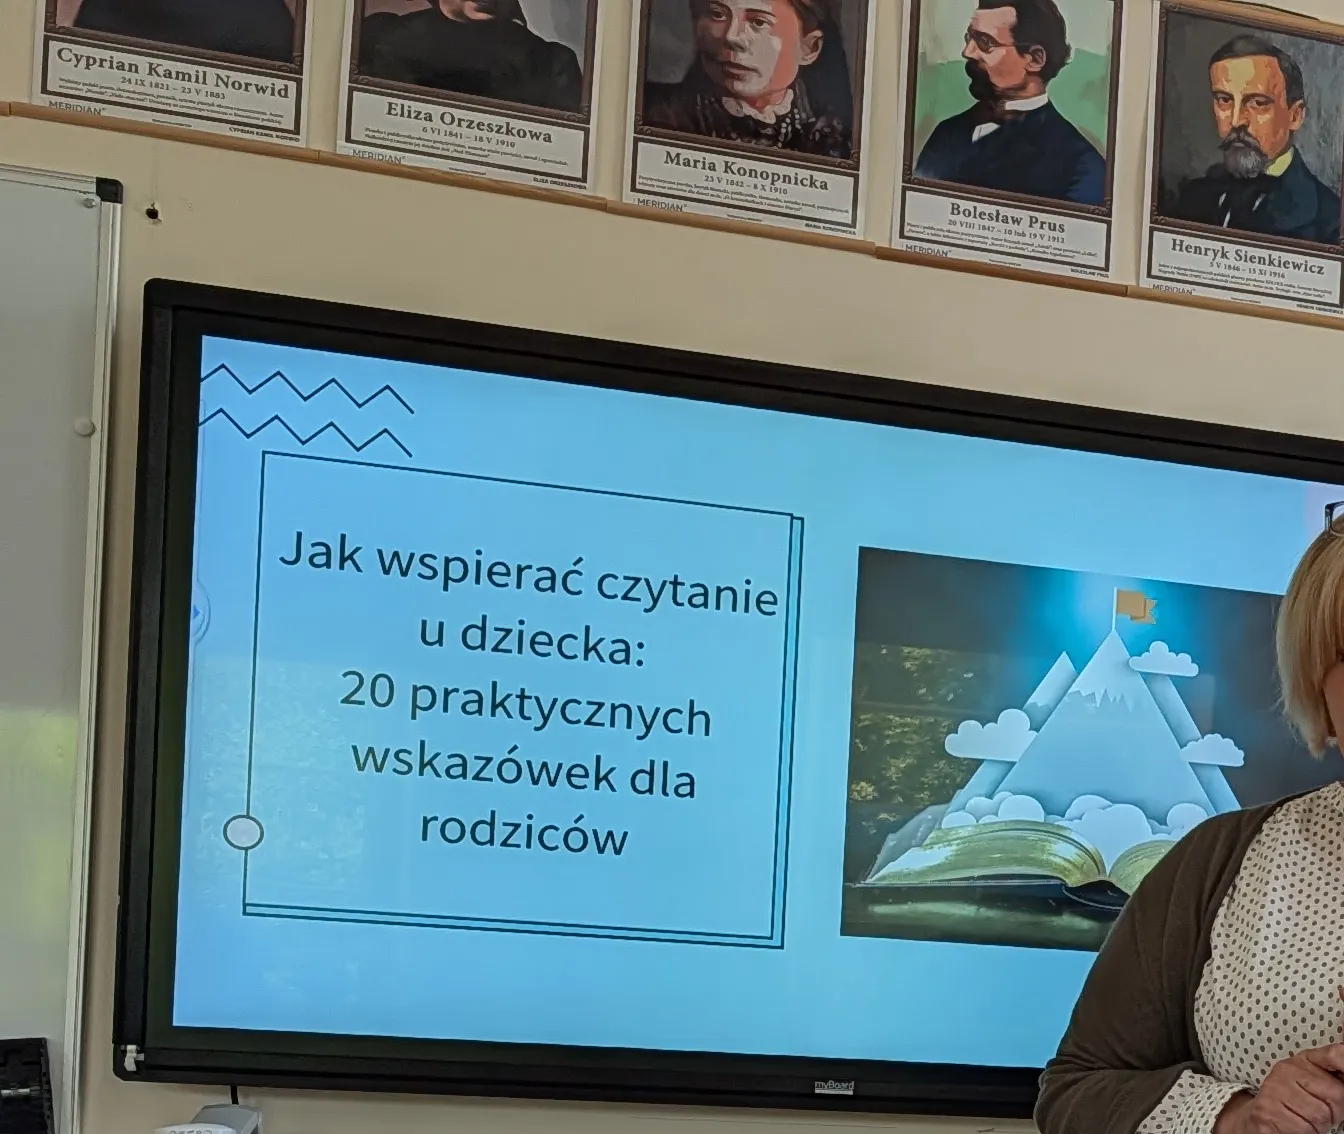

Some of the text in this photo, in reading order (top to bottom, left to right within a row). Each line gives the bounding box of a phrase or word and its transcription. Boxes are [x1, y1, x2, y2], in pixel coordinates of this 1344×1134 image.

[57, 47, 289, 98] Cyprian Kamil Norwid
[120, 76, 132, 84] 24
[134, 78, 146, 87] IX
[150, 80, 169, 90] 1821
[181, 86, 192, 95] 23
[194, 88, 202, 96] V
[386, 101, 553, 143] Eliza Orzeszkowa
[431, 127, 441, 135] VI
[444, 129, 463, 139] 1841
[473, 135, 484, 143] 18
[486, 137, 494, 145] V
[496, 139, 516, 148] 1910
[664, 151, 829, 191] Maria Konopnicka
[725, 178, 744, 188] 1842
[760, 184, 767, 192] X
[769, 186, 787, 195] 1910
[949, 202, 1065, 233] Bolesław Prus
[959, 221, 976, 230] VIII
[978, 223, 995, 232] 1847
[1014, 229, 1026, 238] lub
[1171, 238, 1325, 275] Henryk Sienkiewicz
[1224, 263, 1240, 272] 1846
[1269, 271, 1285, 279] 1916
[278, 531, 780, 617] Jak wspierać czytanie
[419, 614, 646, 667] u dziecka:
[339, 670, 712, 742] 20 praktycznych
[350, 740, 696, 799] wskazówek dla
[420, 810, 629, 856] rodziców
[815, 1080, 854, 1090] myBoard
